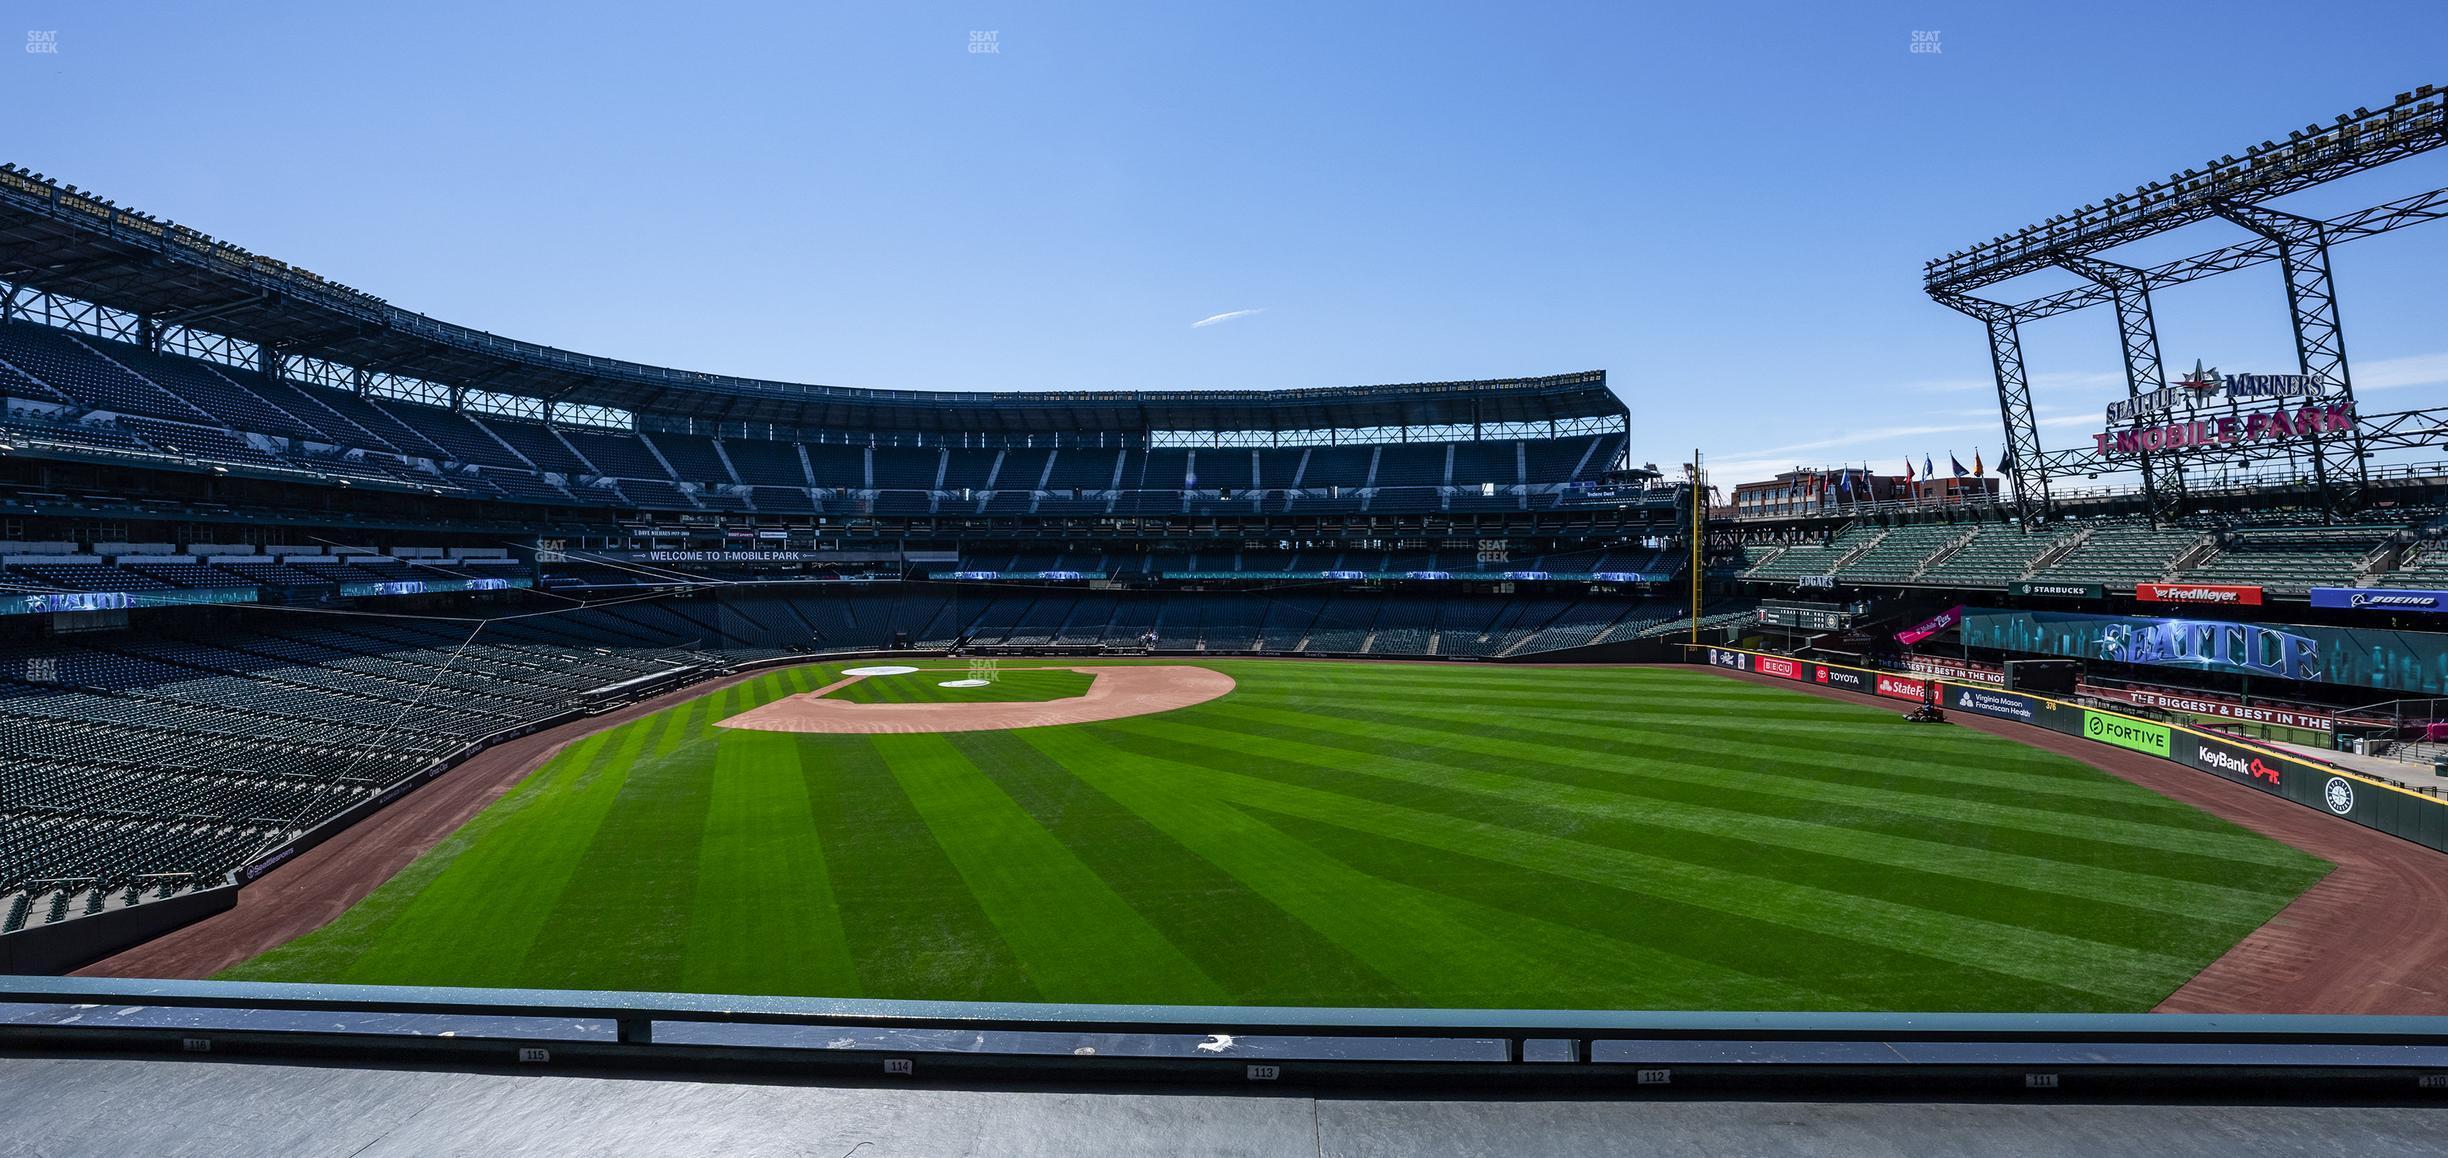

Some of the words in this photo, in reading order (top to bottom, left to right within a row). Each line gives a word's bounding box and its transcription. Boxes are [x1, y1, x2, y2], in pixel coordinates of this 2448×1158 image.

[2106, 388, 2182, 425] SEATTLE
[2225, 373, 2326, 397] MARINERS
[2093, 416, 2241, 456] T-MOBILE
[2246, 400, 2359, 441] PARK
[650, 551, 702, 561] WELCOME
[706, 551, 720, 561] TO
[724, 551, 770, 561] T-MOBILE
[772, 551, 799, 561] PARK
[2034, 586, 2084, 595] STARBUCKS
[2369, 595, 2435, 605] BOEING
[1765, 661, 1790, 673] BECU
[1830, 671, 1860, 685] TOYOTA
[1934, 666, 1955, 676] BEST
[1957, 670, 1966, 678] IN
[1968, 671, 1985, 681] THE
[1975, 693, 1999, 705] Virginia
[2000, 697, 2023, 707] Mason
[2045, 701, 2057, 711] 376
[1975, 702, 2010, 713] Franciscan
[2011, 707, 2031, 718] Health
[2131, 693, 2154, 704] THE
[2158, 697, 2216, 714] BIGGEST
[2220, 705, 2229, 715] &
[2235, 708, 2272, 722] BEST
[2277, 713, 2294, 725] IN
[2298, 715, 2331, 730] THE
[2106, 723, 2164, 748] FORTIVE
[2199, 745, 2249, 775] KeyBank
[527, 1050, 544, 1060] 115
[891, 1061, 909, 1071] 114
[1254, 1067, 1273, 1078] 113
[1645, 1072, 1664, 1081] 112
[2034, 1076, 2051, 1086] 111
